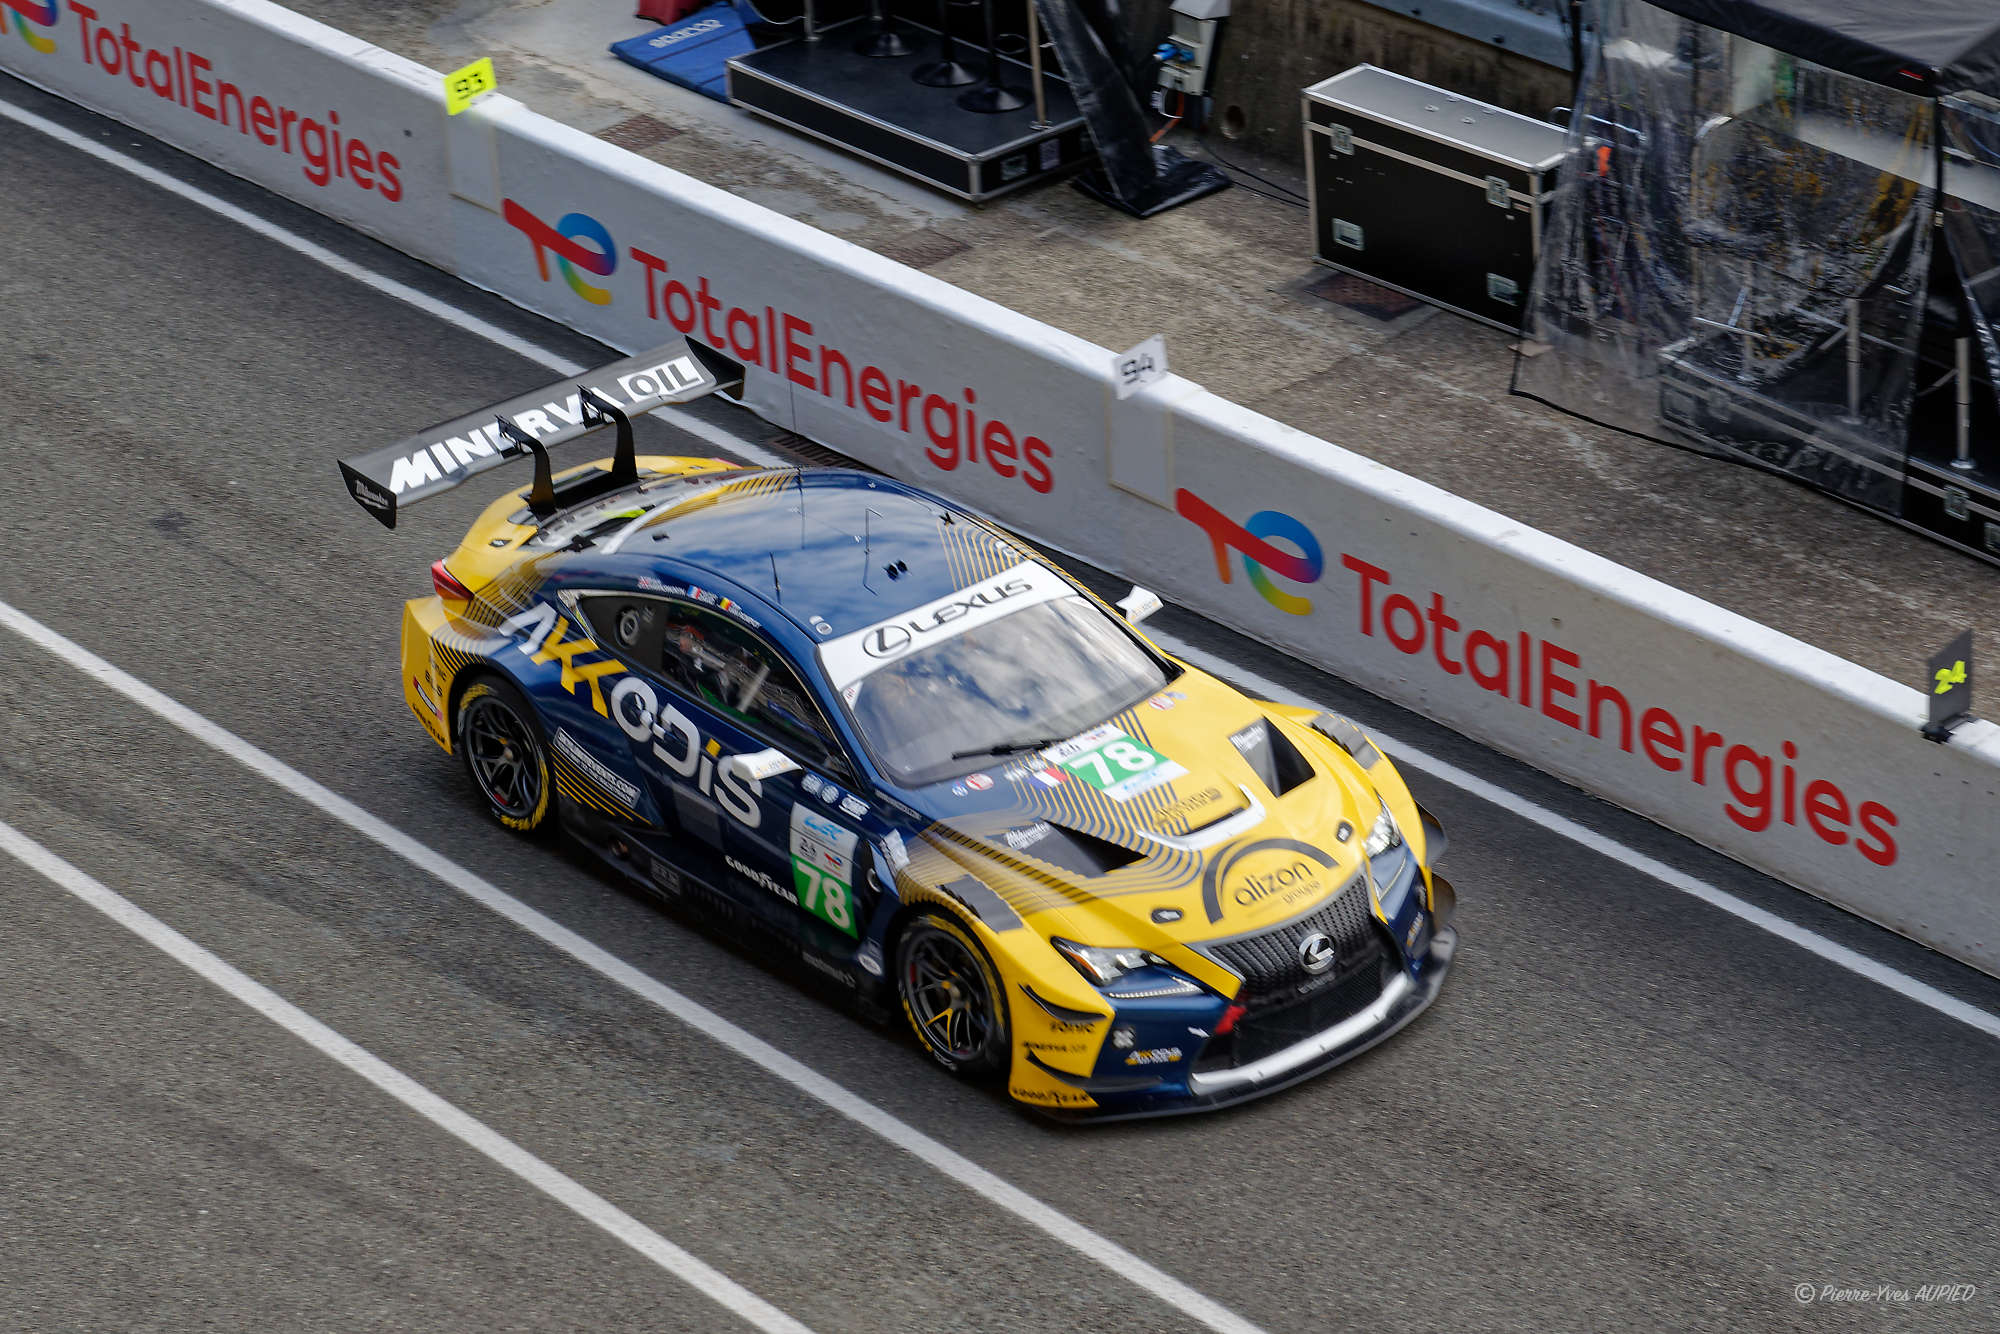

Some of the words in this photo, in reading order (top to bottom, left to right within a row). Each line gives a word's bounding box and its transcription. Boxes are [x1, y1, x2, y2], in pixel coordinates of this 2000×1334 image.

[66, 0, 402, 203] TotalEnergies
[628, 362, 700, 397] OIL
[630, 246, 1055, 494] TotalEnergies
[908, 577, 1033, 633] LEXUS
[1933, 660, 1968, 695] 24
[1341, 552, 1900, 867] TotalEnergies
[1068, 741, 1156, 787] 78
[796, 860, 850, 929] 78
[1235, 861, 1314, 906] alizon
